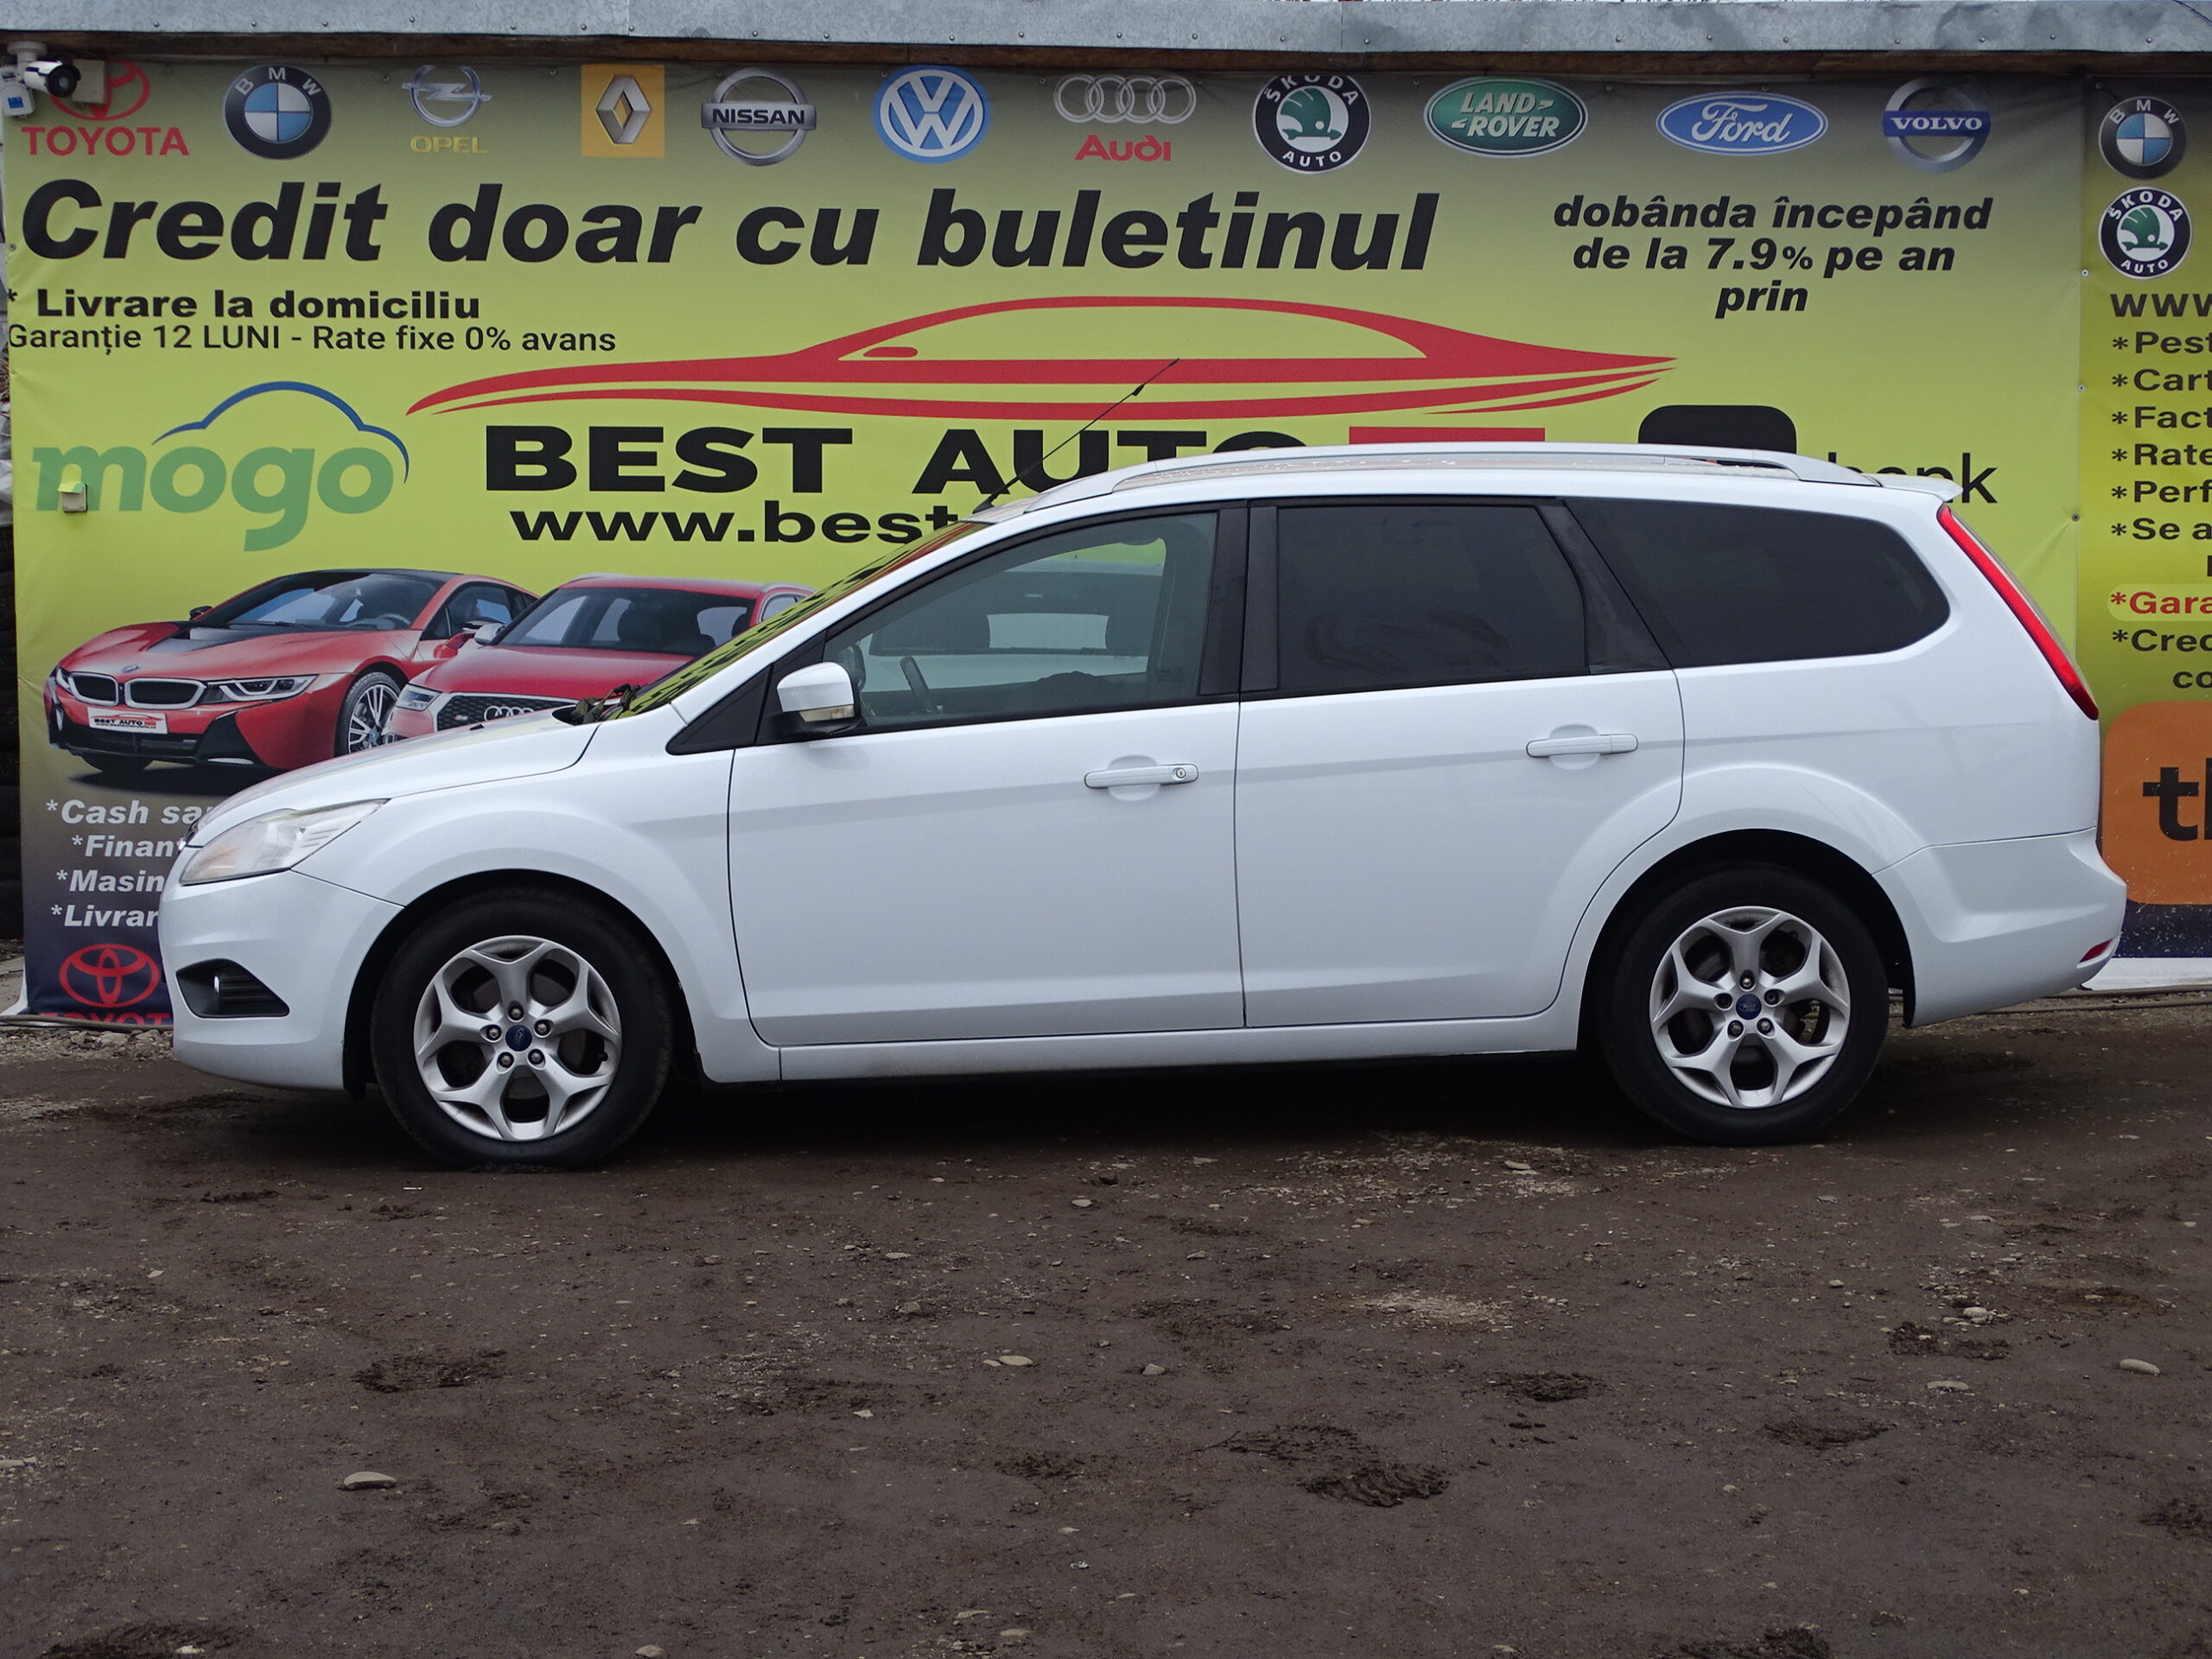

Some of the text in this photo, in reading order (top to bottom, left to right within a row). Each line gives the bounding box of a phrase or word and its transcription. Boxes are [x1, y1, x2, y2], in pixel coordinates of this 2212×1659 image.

[234, 67, 321, 96] BMW
[712, 108, 805, 126] NISSAN
[1693, 99, 1791, 143] Ford
[1891, 117, 1982, 131] VOLVO
[2109, 99, 2179, 124] BMW
[21, 126, 189, 156] TOYOTA
[410, 136, 487, 154] OPEL
[1074, 134, 1171, 162] Audi
[1282, 150, 1341, 167] AUTO
[22, 179, 1440, 270] Credit doar cu buletinul
[1553, 194, 1993, 237] dobânda începând
[1573, 237, 1630, 270] de
[1645, 238, 1688, 270] la
[1823, 246, 1883, 279] pe
[1898, 246, 1956, 271] an
[2121, 258, 2169, 274] AUTO
[37, 289, 480, 319] Livrare la domiciliu
[1715, 280, 1809, 319] prin
[9, 324, 142, 355] Garanție
[155, 326, 192, 348] 12
[204, 326, 280, 349] LUNI
[314, 327, 386, 350] Rate
[395, 324, 454, 350] fixe
[465, 327, 512, 351] 0%
[522, 332, 615, 352] avans
[486, 425, 1306, 495] BEST AUT
[32, 445, 394, 552] mogo
[72, 835, 181, 857] Finan
